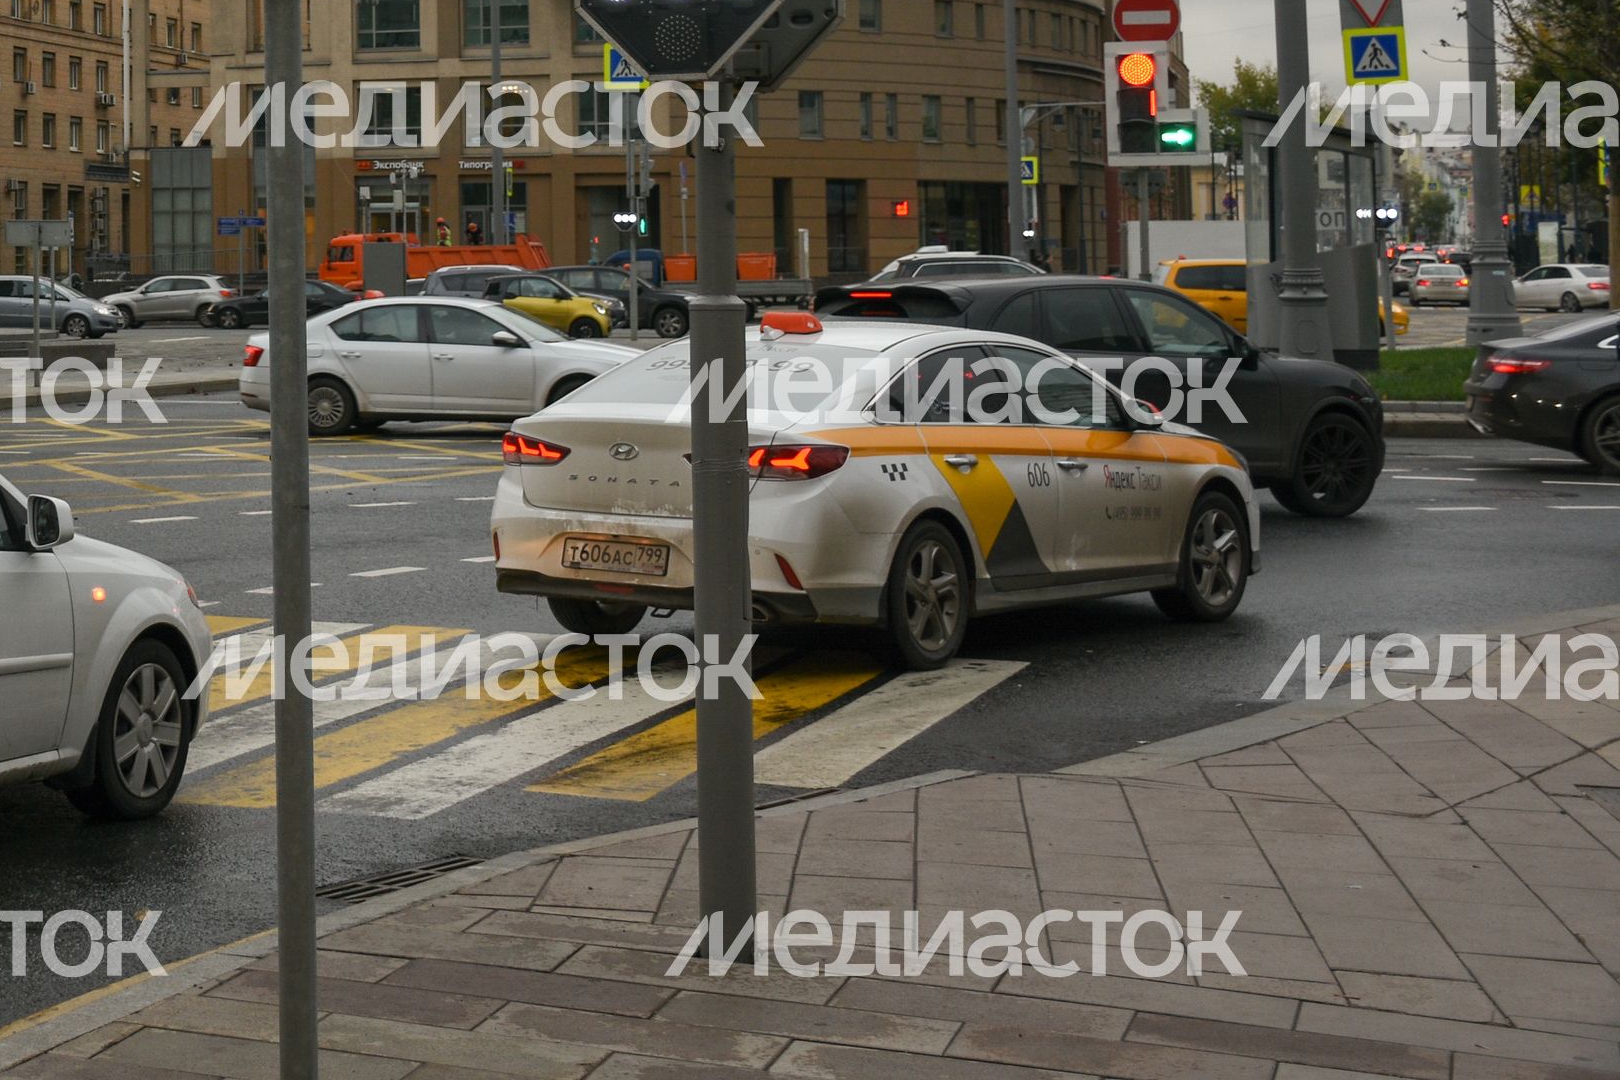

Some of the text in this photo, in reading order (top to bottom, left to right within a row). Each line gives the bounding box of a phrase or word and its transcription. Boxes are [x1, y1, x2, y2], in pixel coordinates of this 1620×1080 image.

[373, 159, 425, 170] Экспобанк
[458, 160, 513, 170] Типограия
[569, 474, 681, 488] SONATA
[1027, 462, 1051, 488] 606
[1103, 464, 1162, 491] Яндекс Такси
[570, 542, 663, 566] Т606АС 799
